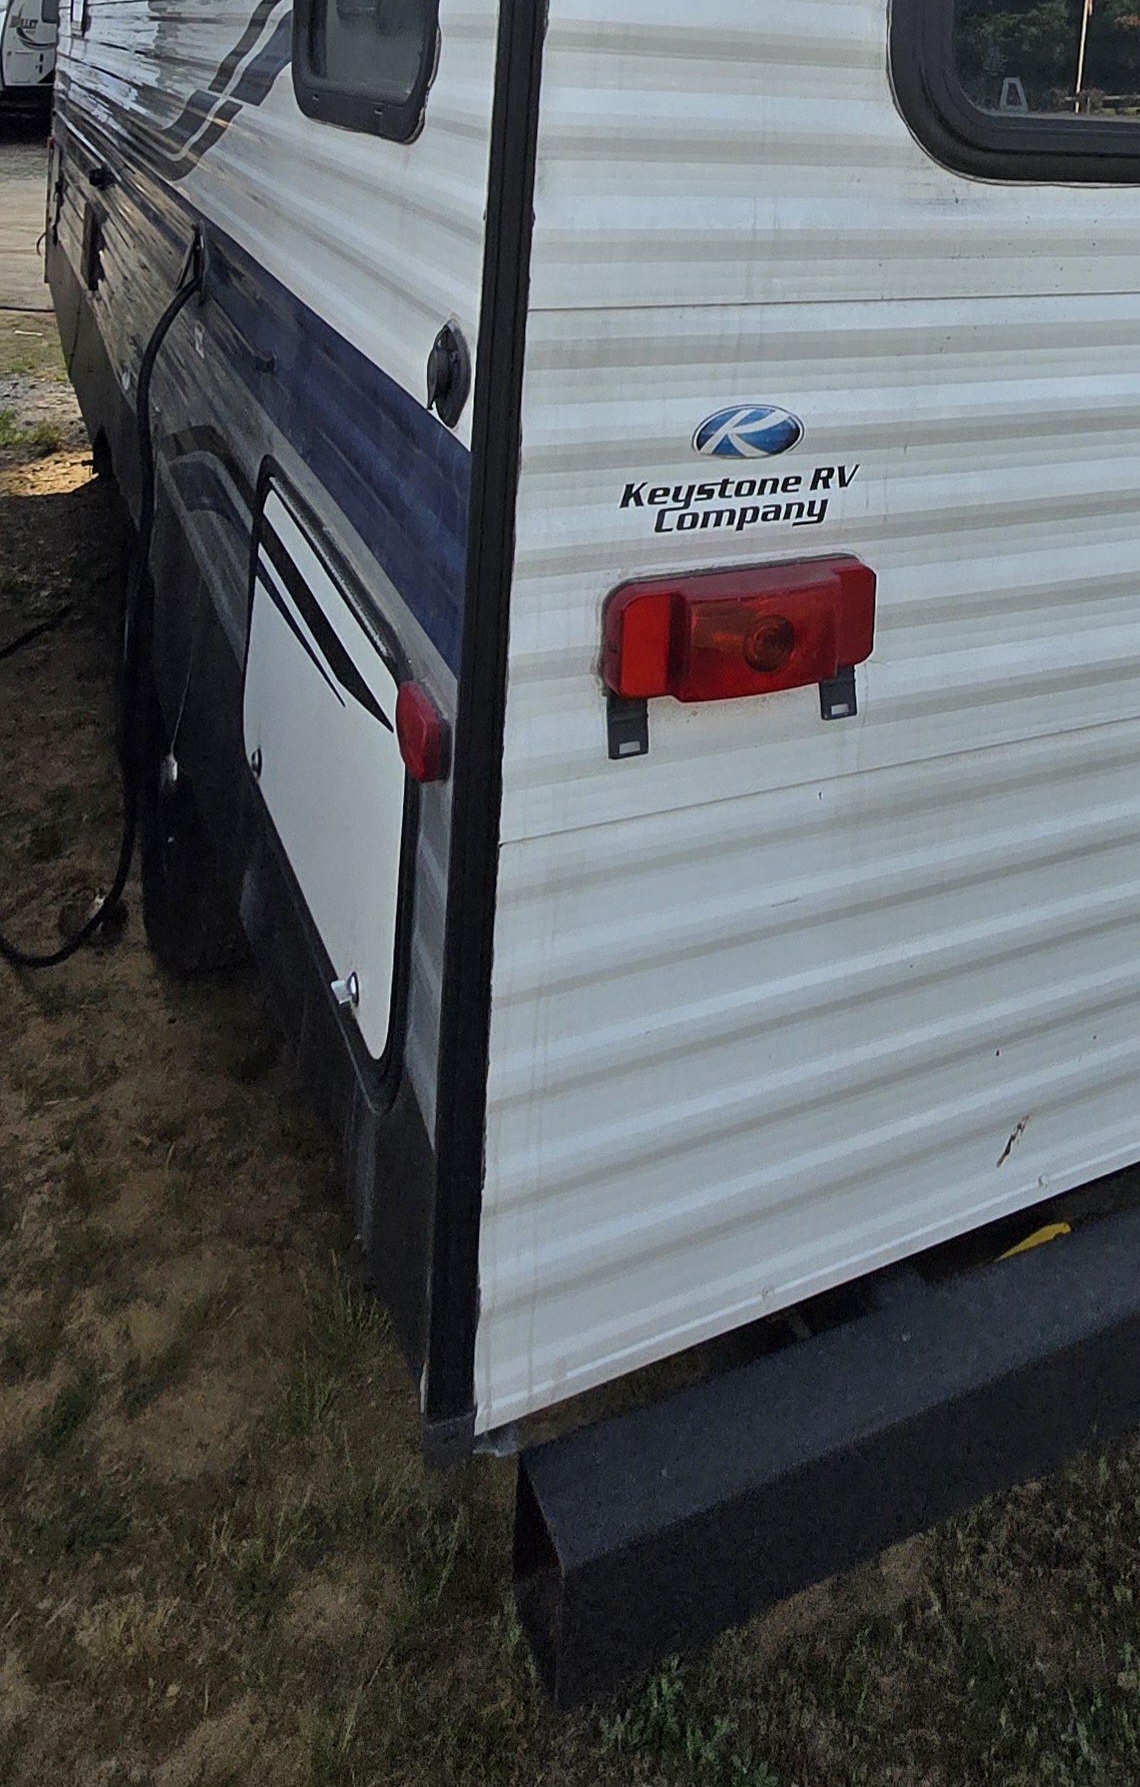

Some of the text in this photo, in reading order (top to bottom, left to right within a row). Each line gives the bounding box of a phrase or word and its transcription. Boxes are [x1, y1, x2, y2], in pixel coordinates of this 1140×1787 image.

[619, 463, 861, 511] Keystone RV
[653, 498, 829, 533] Company
